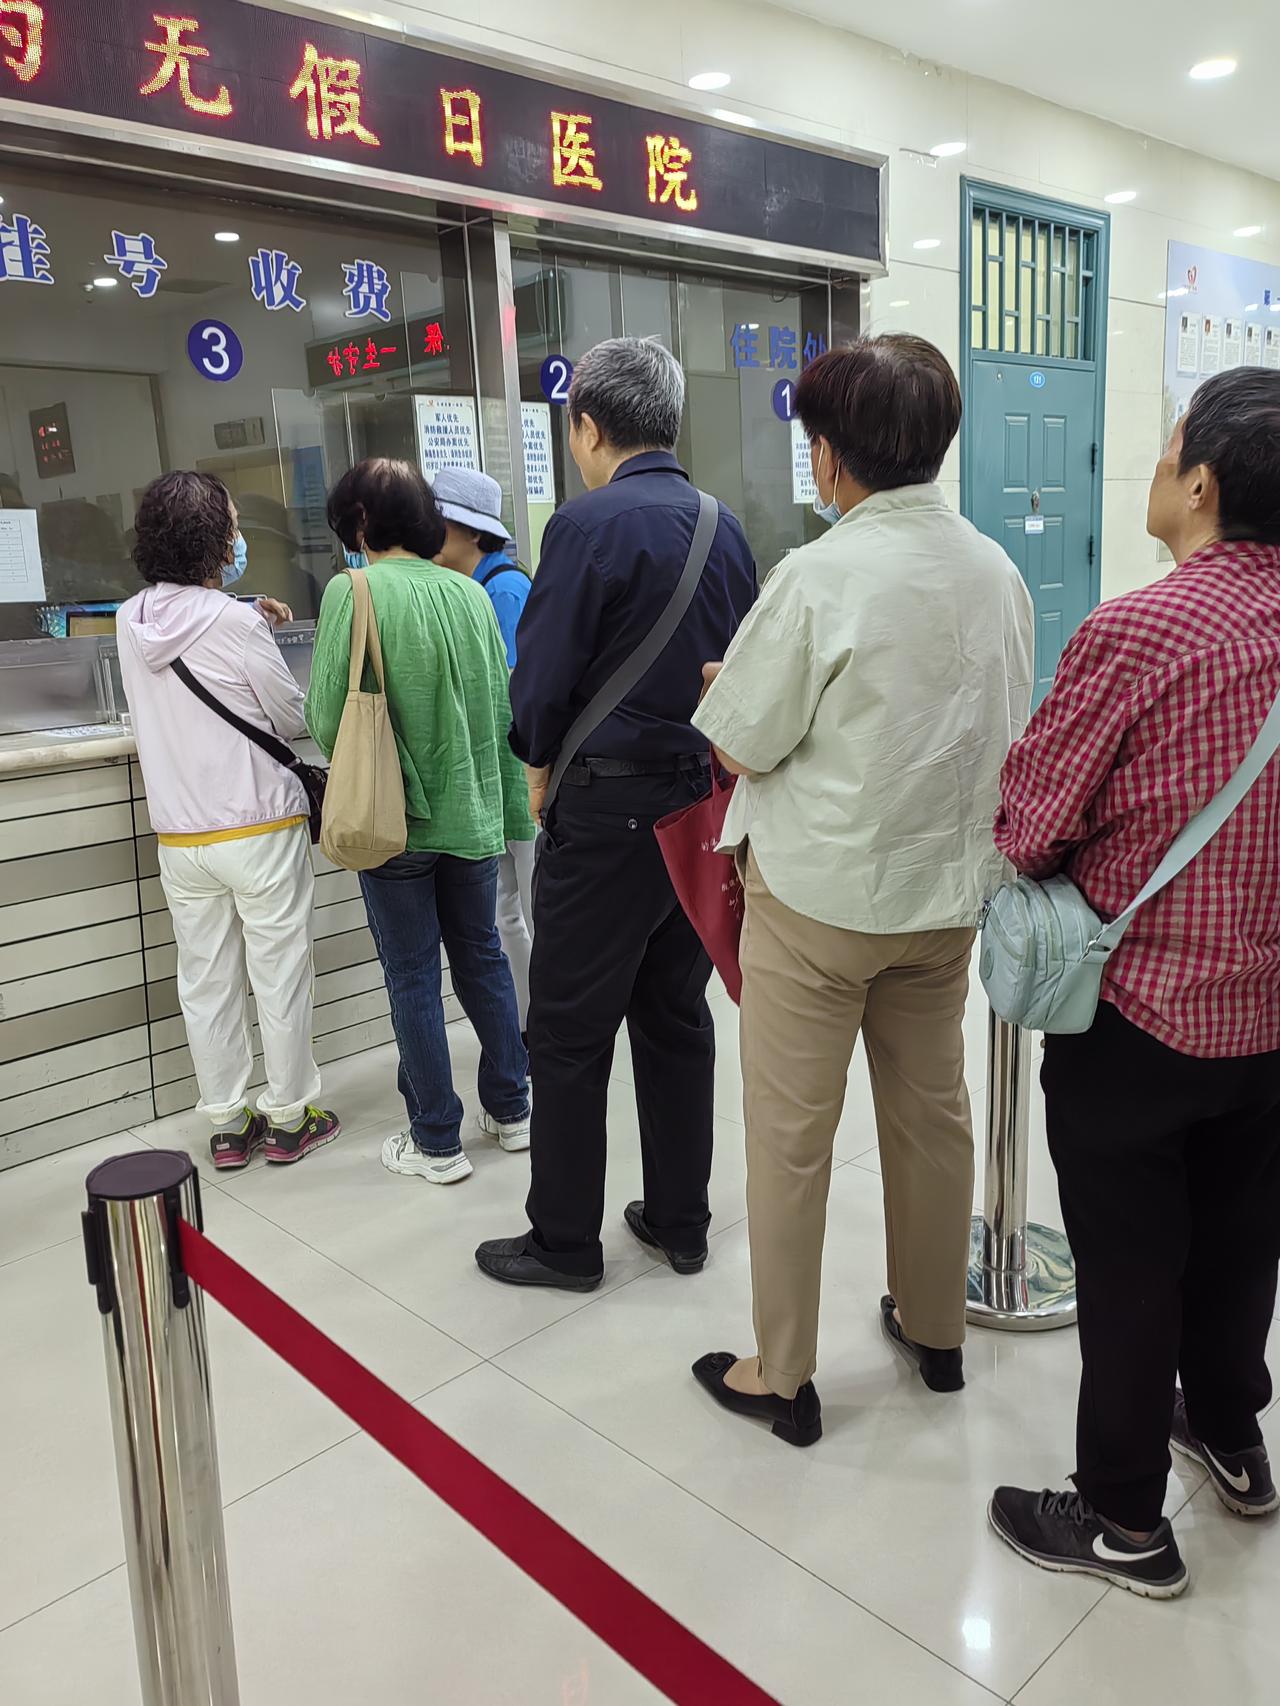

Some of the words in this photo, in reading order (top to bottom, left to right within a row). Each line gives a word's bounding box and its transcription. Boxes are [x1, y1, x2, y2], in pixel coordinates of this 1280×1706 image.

[0, 213, 392, 322] 挂号收费
[202, 326, 230, 374] 3
[730, 322, 827, 370] 住院处
[549, 360, 569, 399] 2
[781, 384, 791, 417] 1
[435, 413, 459, 423] 军人优先
